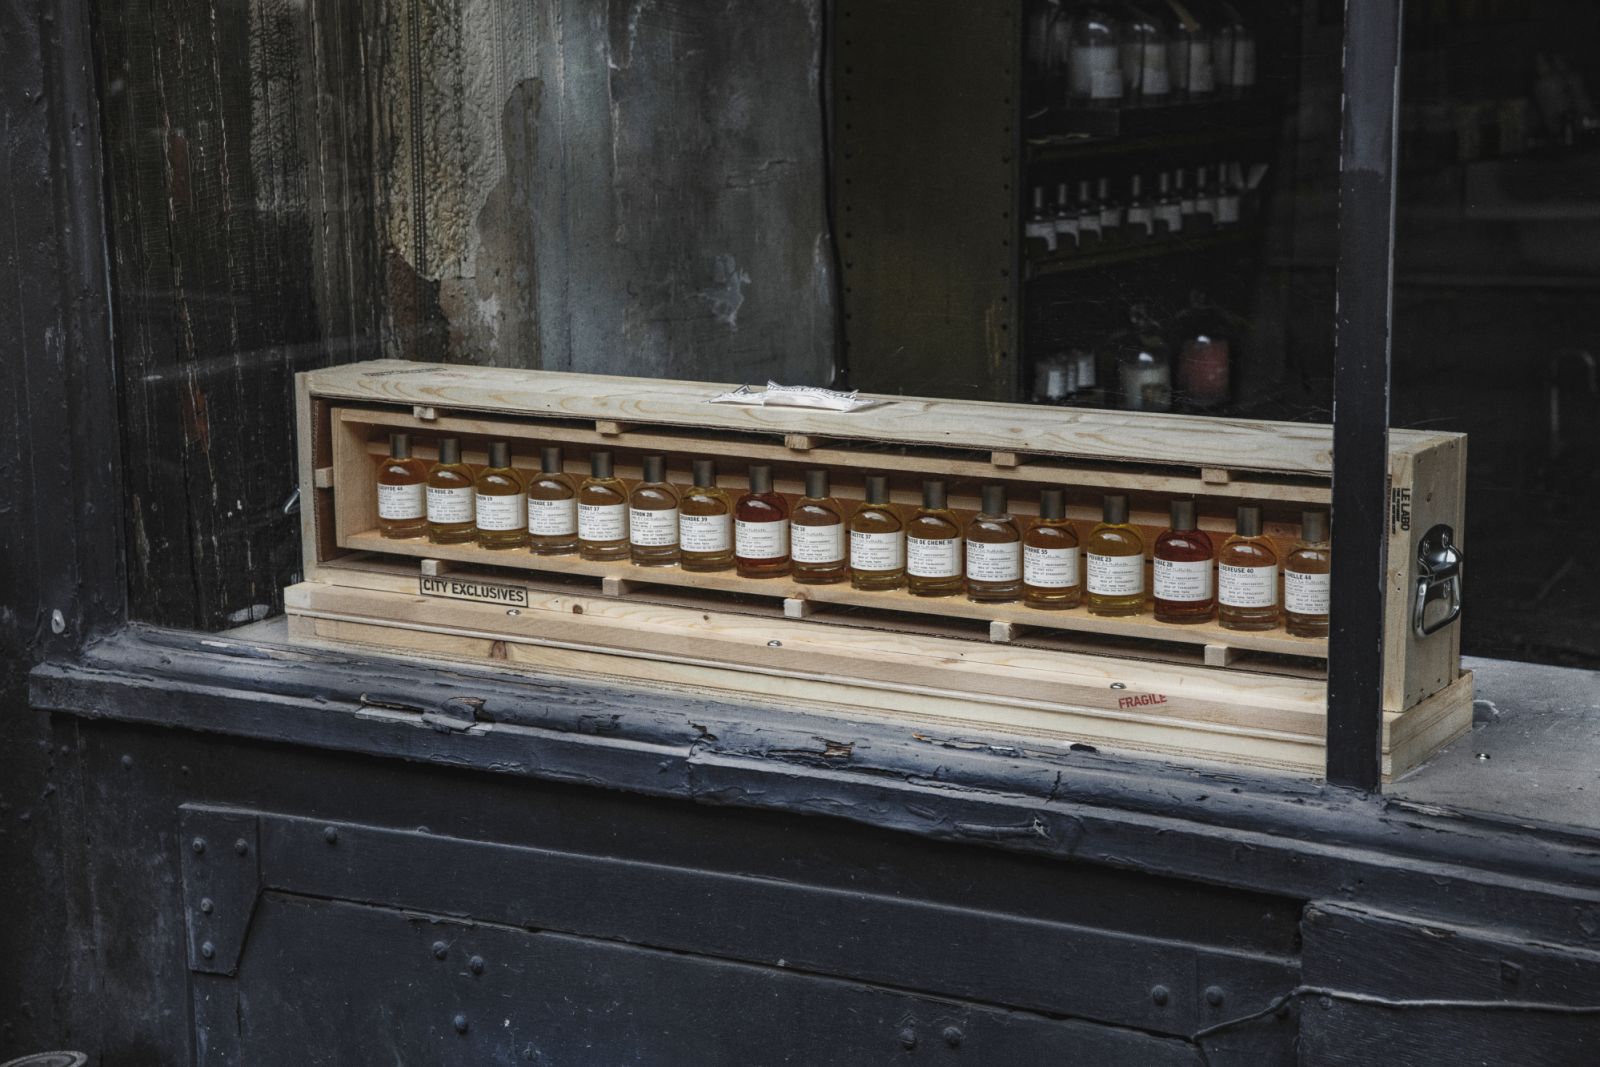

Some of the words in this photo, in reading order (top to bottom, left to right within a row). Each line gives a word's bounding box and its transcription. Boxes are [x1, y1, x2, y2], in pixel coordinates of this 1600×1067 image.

[1400, 488, 1411, 501] LE
[1400, 503, 1411, 531] LABO
[423, 579, 449, 594] CITY
[451, 582, 525, 603] EXCLUSIVES
[1118, 693, 1168, 710] FRAGILE
